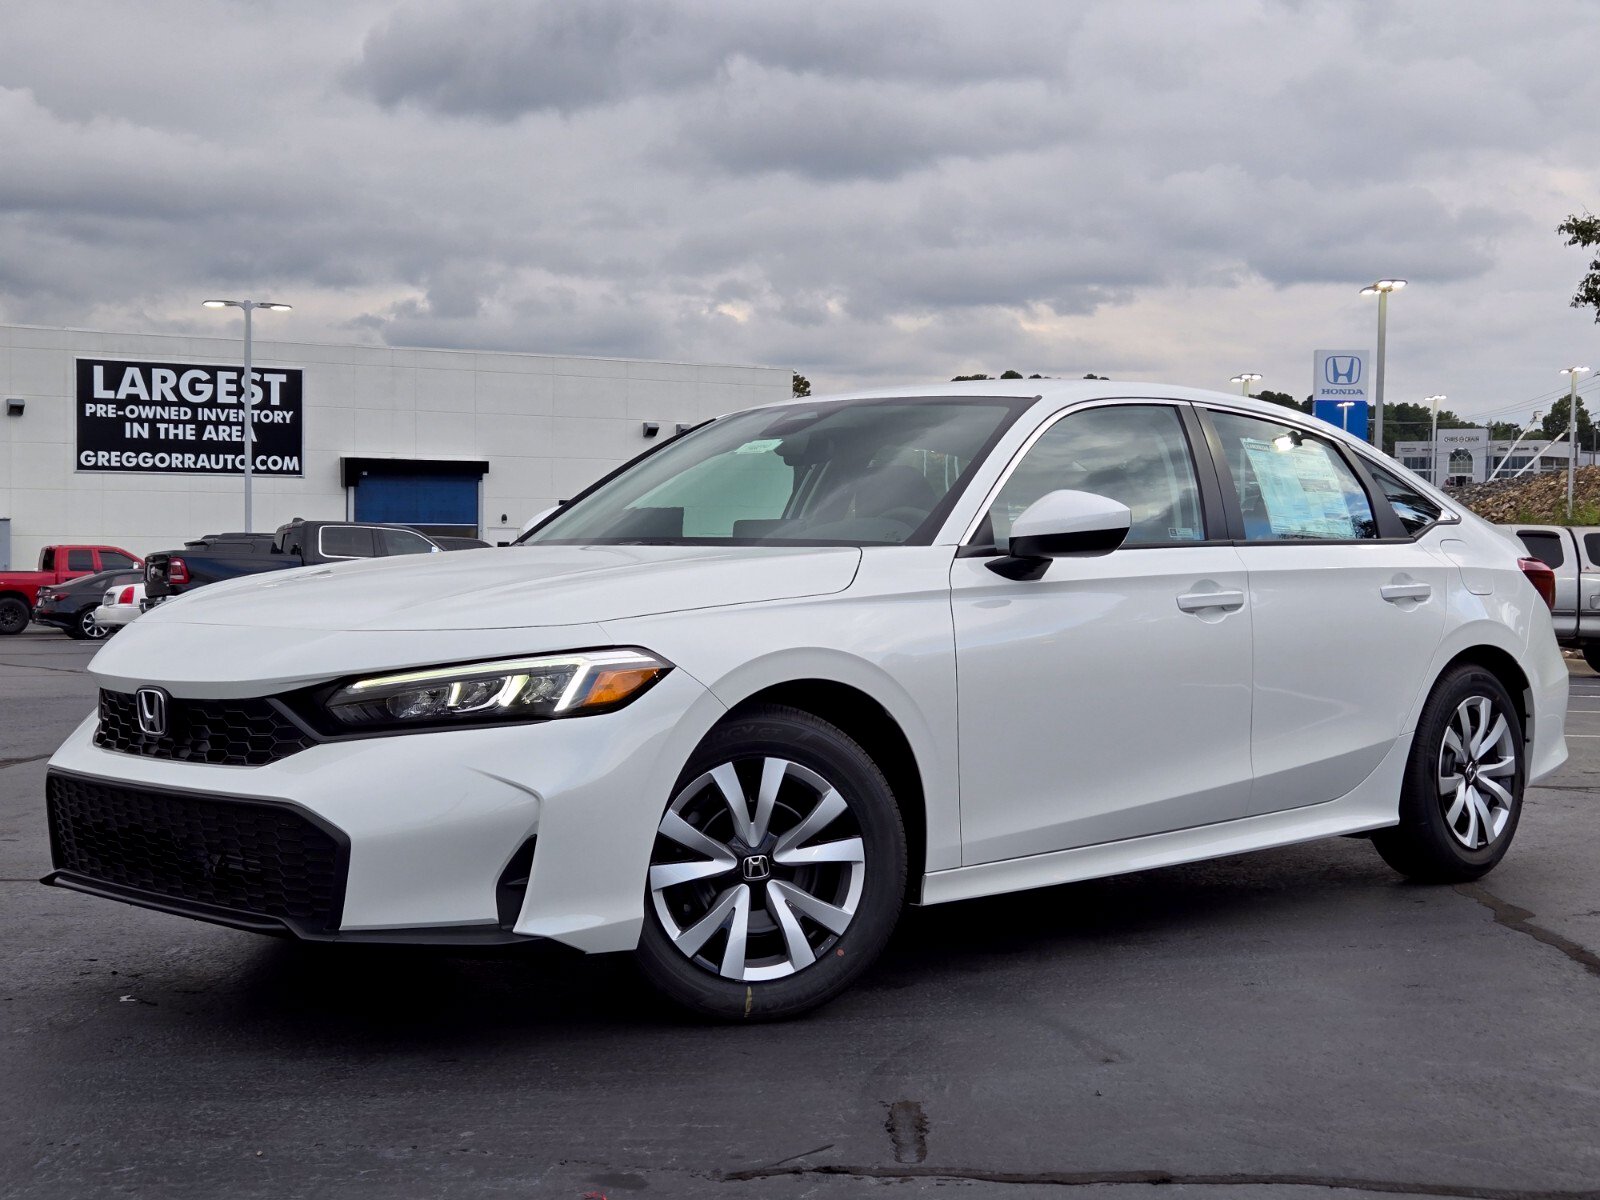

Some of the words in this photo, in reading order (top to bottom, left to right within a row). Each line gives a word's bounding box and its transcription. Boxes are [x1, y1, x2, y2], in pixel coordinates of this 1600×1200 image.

[92, 365, 287, 406] LARGEST
[85, 403, 192, 420] PRE-OWNED
[197, 407, 294, 424] INVENTORY
[124, 421, 149, 439] IN
[156, 423, 196, 440] THE
[79, 450, 300, 471] GREGGORRAUTO.COM
